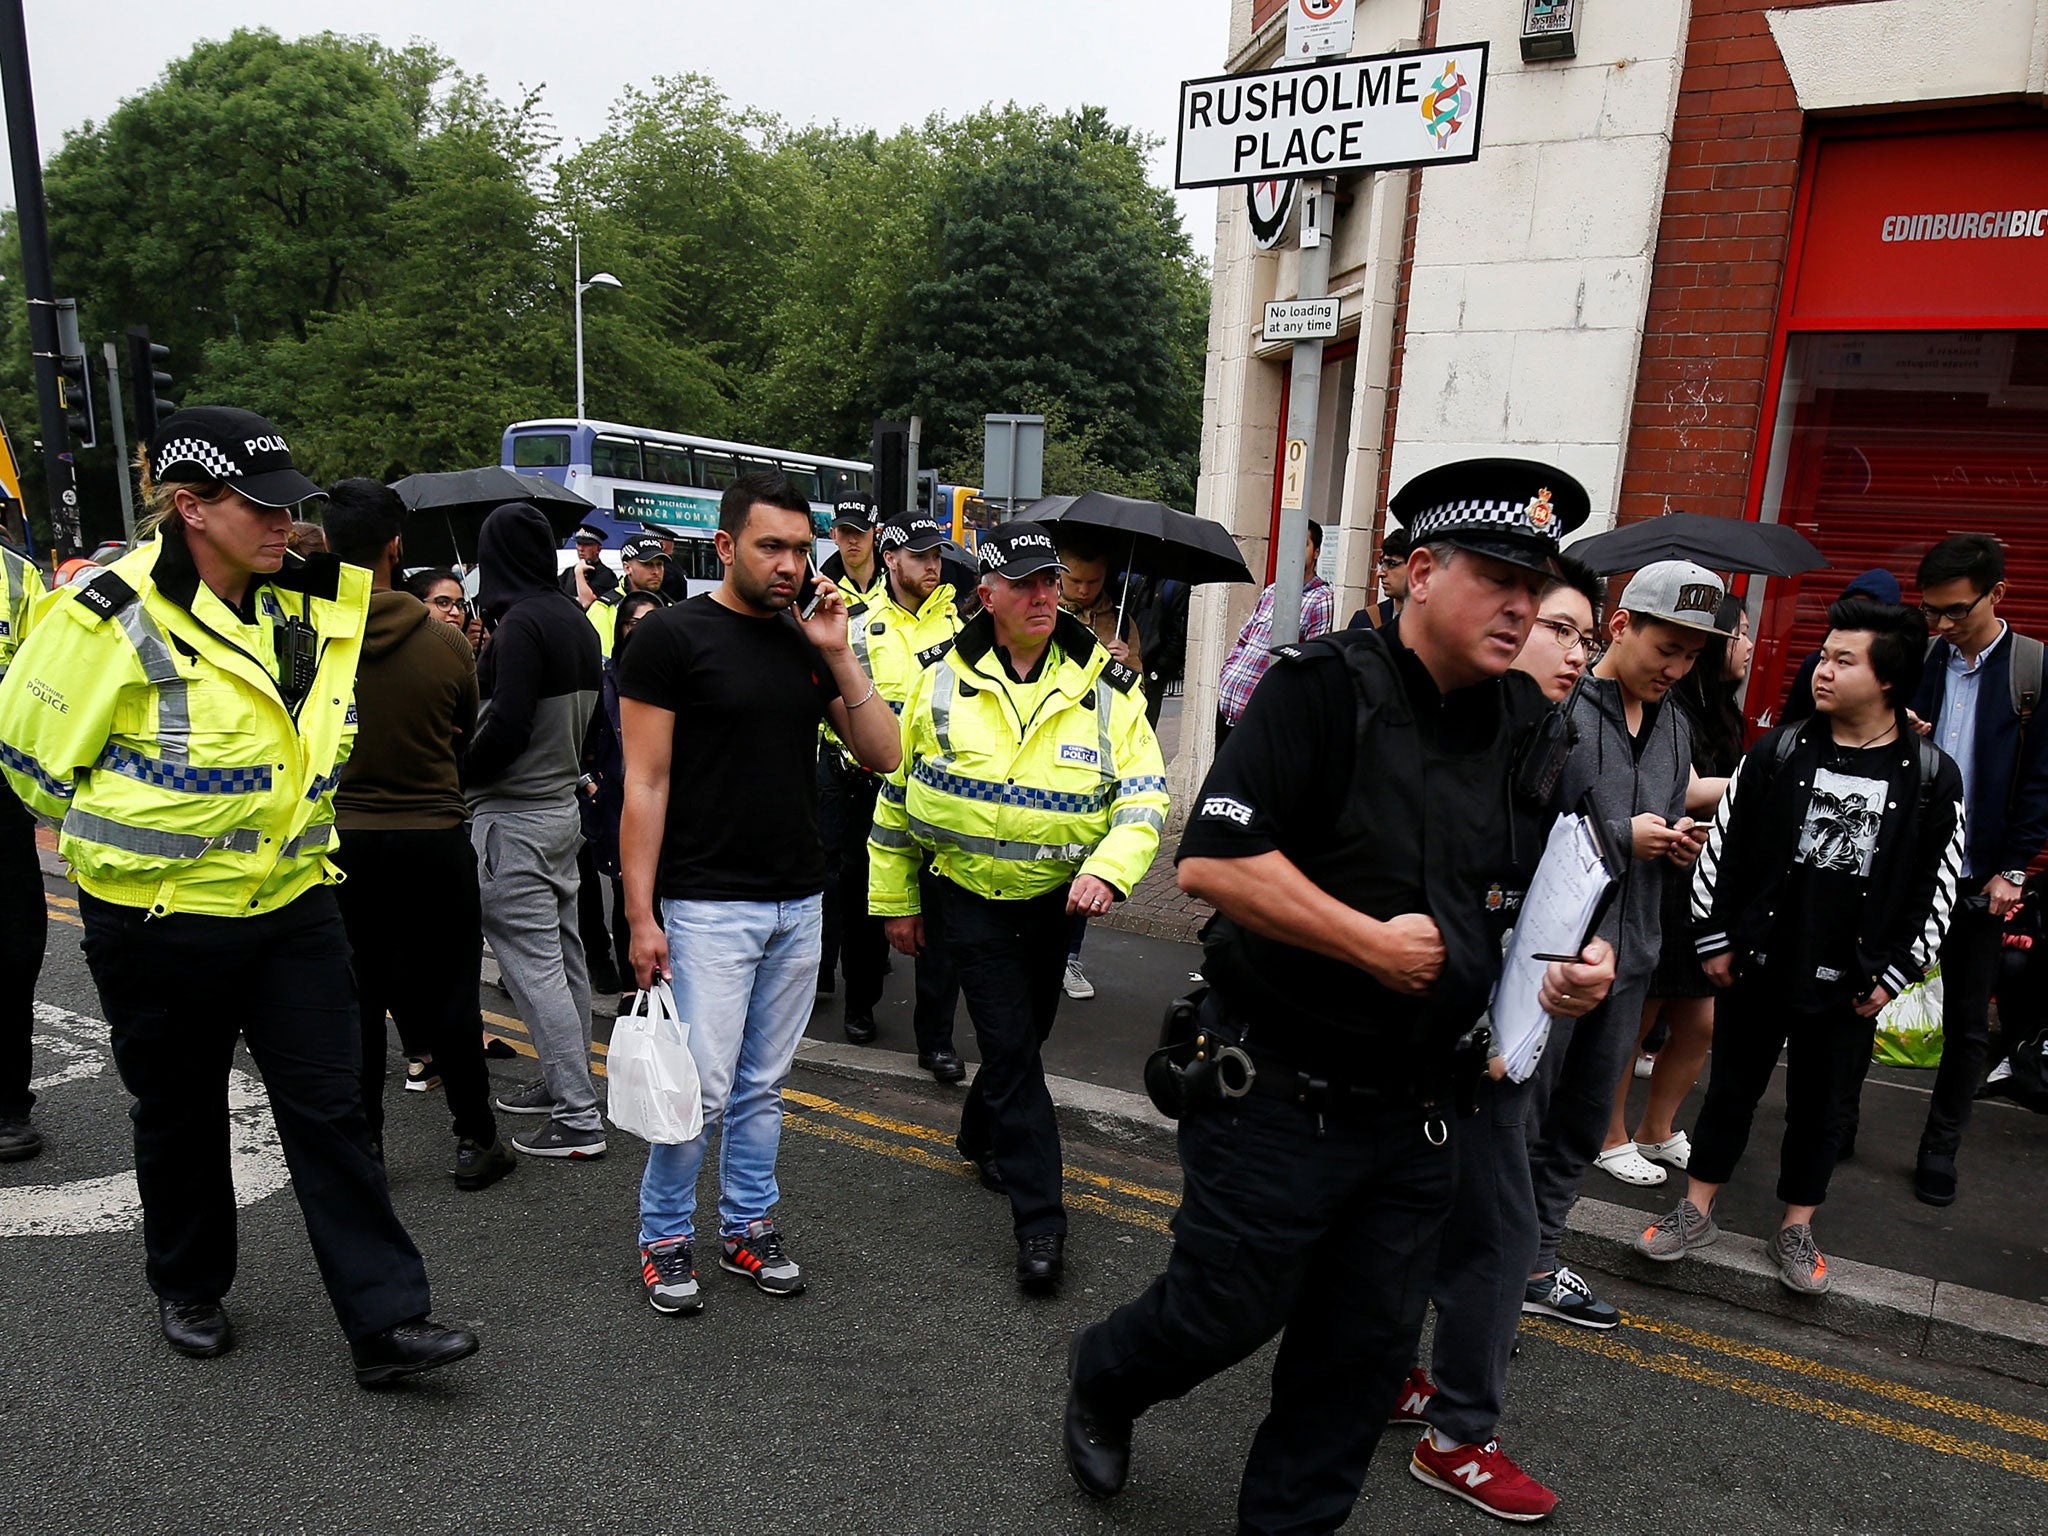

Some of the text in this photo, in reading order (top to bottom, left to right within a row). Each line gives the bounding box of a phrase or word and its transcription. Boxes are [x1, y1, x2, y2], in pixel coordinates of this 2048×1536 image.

[1531, 14, 1566, 25] SYSTEMS
[1189, 62, 1421, 129] RUSHOLME
[1234, 121, 1363, 172] PLACE
[1306, 198, 1316, 227] 1
[1882, 209, 2048, 242] EDINBURGHBIC
[1270, 305, 1331, 318] No loading
[1269, 319, 1331, 333] at any time
[243, 435, 290, 456] POLIC
[1288, 472, 1296, 492] 1
[618, 505, 716, 522] WONDER WOMAN
[658, 500, 697, 509] SPECTACULAR
[838, 502, 866, 512] POLICE
[911, 520, 939, 531] POLIC
[639, 539, 661, 548] POLIC
[1010, 534, 1051, 550] POLICE
[85, 588, 111, 608] 2933
[26, 680, 69, 714] POLICE
[34, 678, 65, 700] CHESHIRE
[1063, 750, 1096, 762] POLICE
[1201, 802, 1251, 825] POLICE
[1401, 1392, 1430, 1415] N
[1452, 1460, 1494, 1488] N
